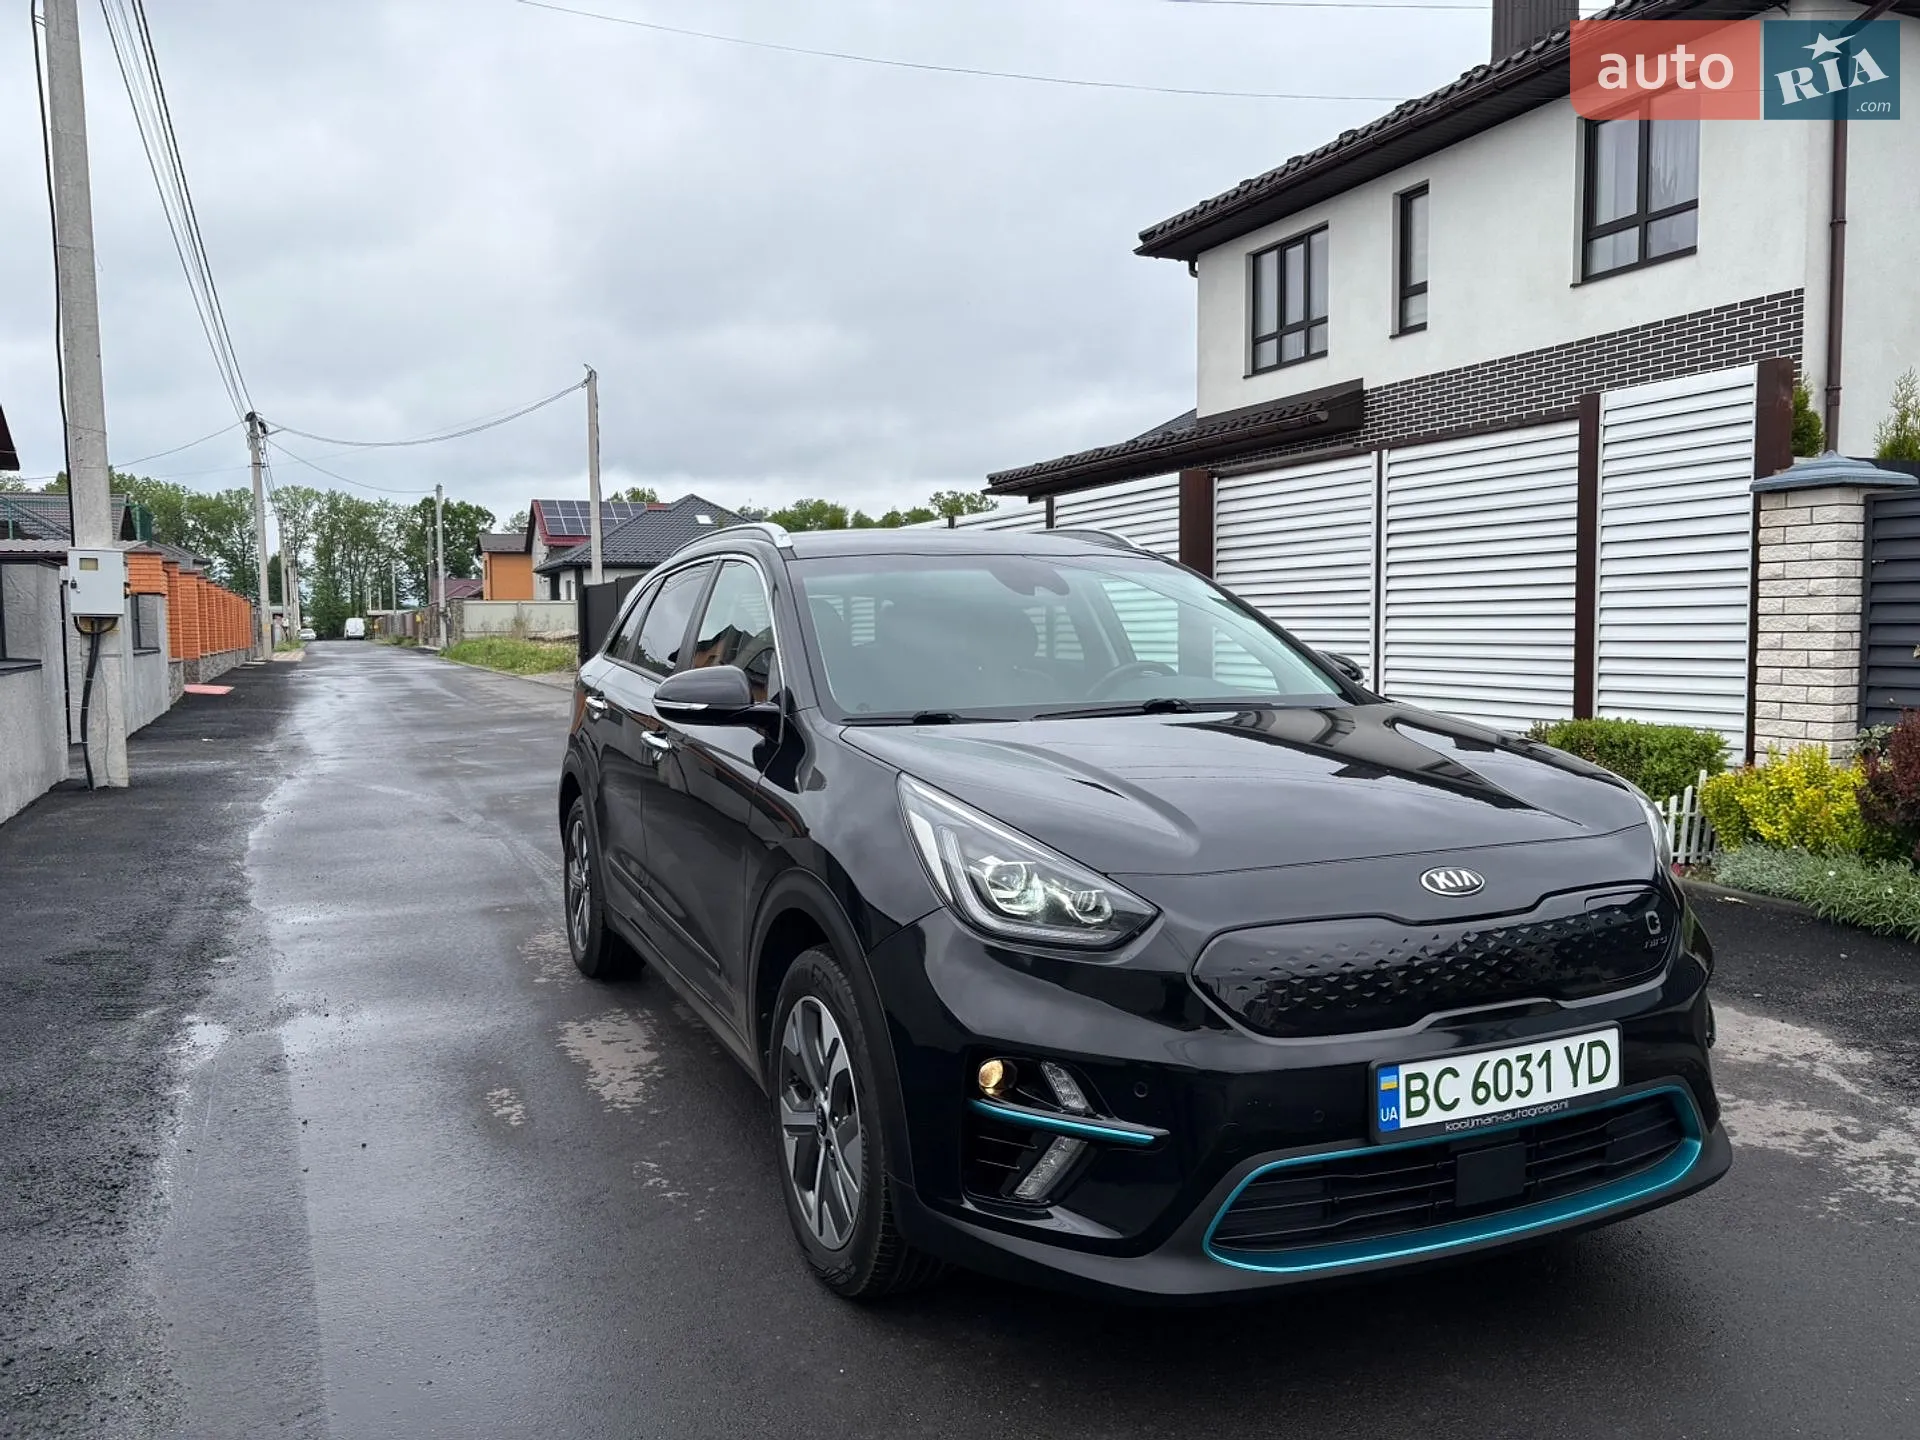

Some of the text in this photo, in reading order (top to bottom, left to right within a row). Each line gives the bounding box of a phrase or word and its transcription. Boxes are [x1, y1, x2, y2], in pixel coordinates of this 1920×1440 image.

[1430, 870, 1480, 889] KIA
[1405, 1039, 1611, 1119] BC 6031 YD
[1380, 1106, 1399, 1122] UA
